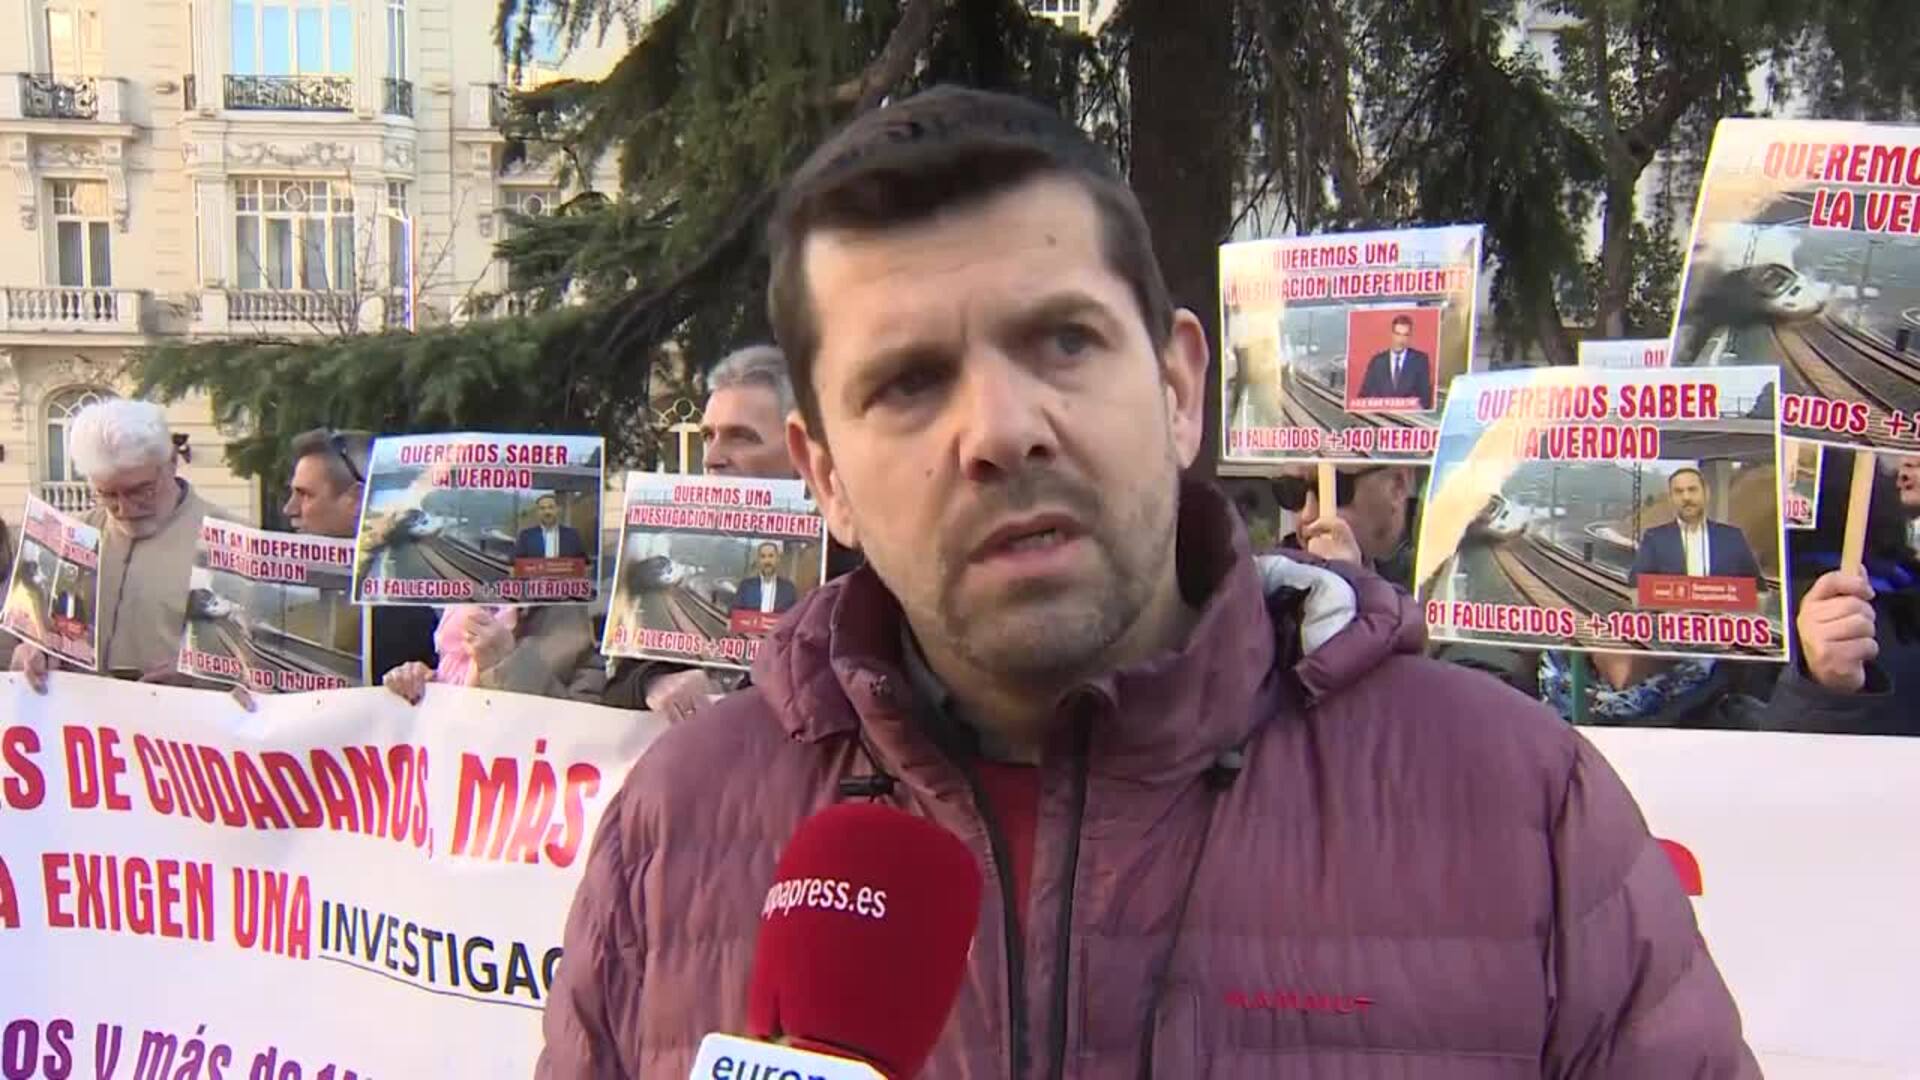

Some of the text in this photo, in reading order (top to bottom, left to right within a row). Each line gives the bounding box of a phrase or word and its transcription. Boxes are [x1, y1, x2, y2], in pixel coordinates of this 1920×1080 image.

[1811, 190, 1852, 228] LA
[1366, 243, 1399, 265] UNA
[1477, 383, 1718, 420] QUEREMOS SABER
[1247, 429, 1319, 448] FALLECIDOS
[1512, 426, 1658, 459] LA VERDAD
[402, 444, 568, 465] QUEREMOS SABER
[432, 469, 532, 489] LA VERDAD
[674, 485, 772, 506] QUEREMOS UNA
[719, 513, 821, 534] INDEPENDIENTE
[363, 579, 378, 596] 81
[383, 579, 472, 597] FALLECIDOS
[528, 579, 590, 598] HERIDOS
[1426, 602, 1446, 626] 81
[1452, 605, 1574, 635] FALLECIDOS
[1660, 613, 1772, 645] HERIDOS
[63, 726, 132, 811] DE
[133, 733, 434, 858] CIUDADANOS,
[450, 740, 601, 868] MÁS
[42, 852, 215, 941] EXIGEN
[232, 867, 312, 959] UNA
[712, 1056, 827, 1080] eur
